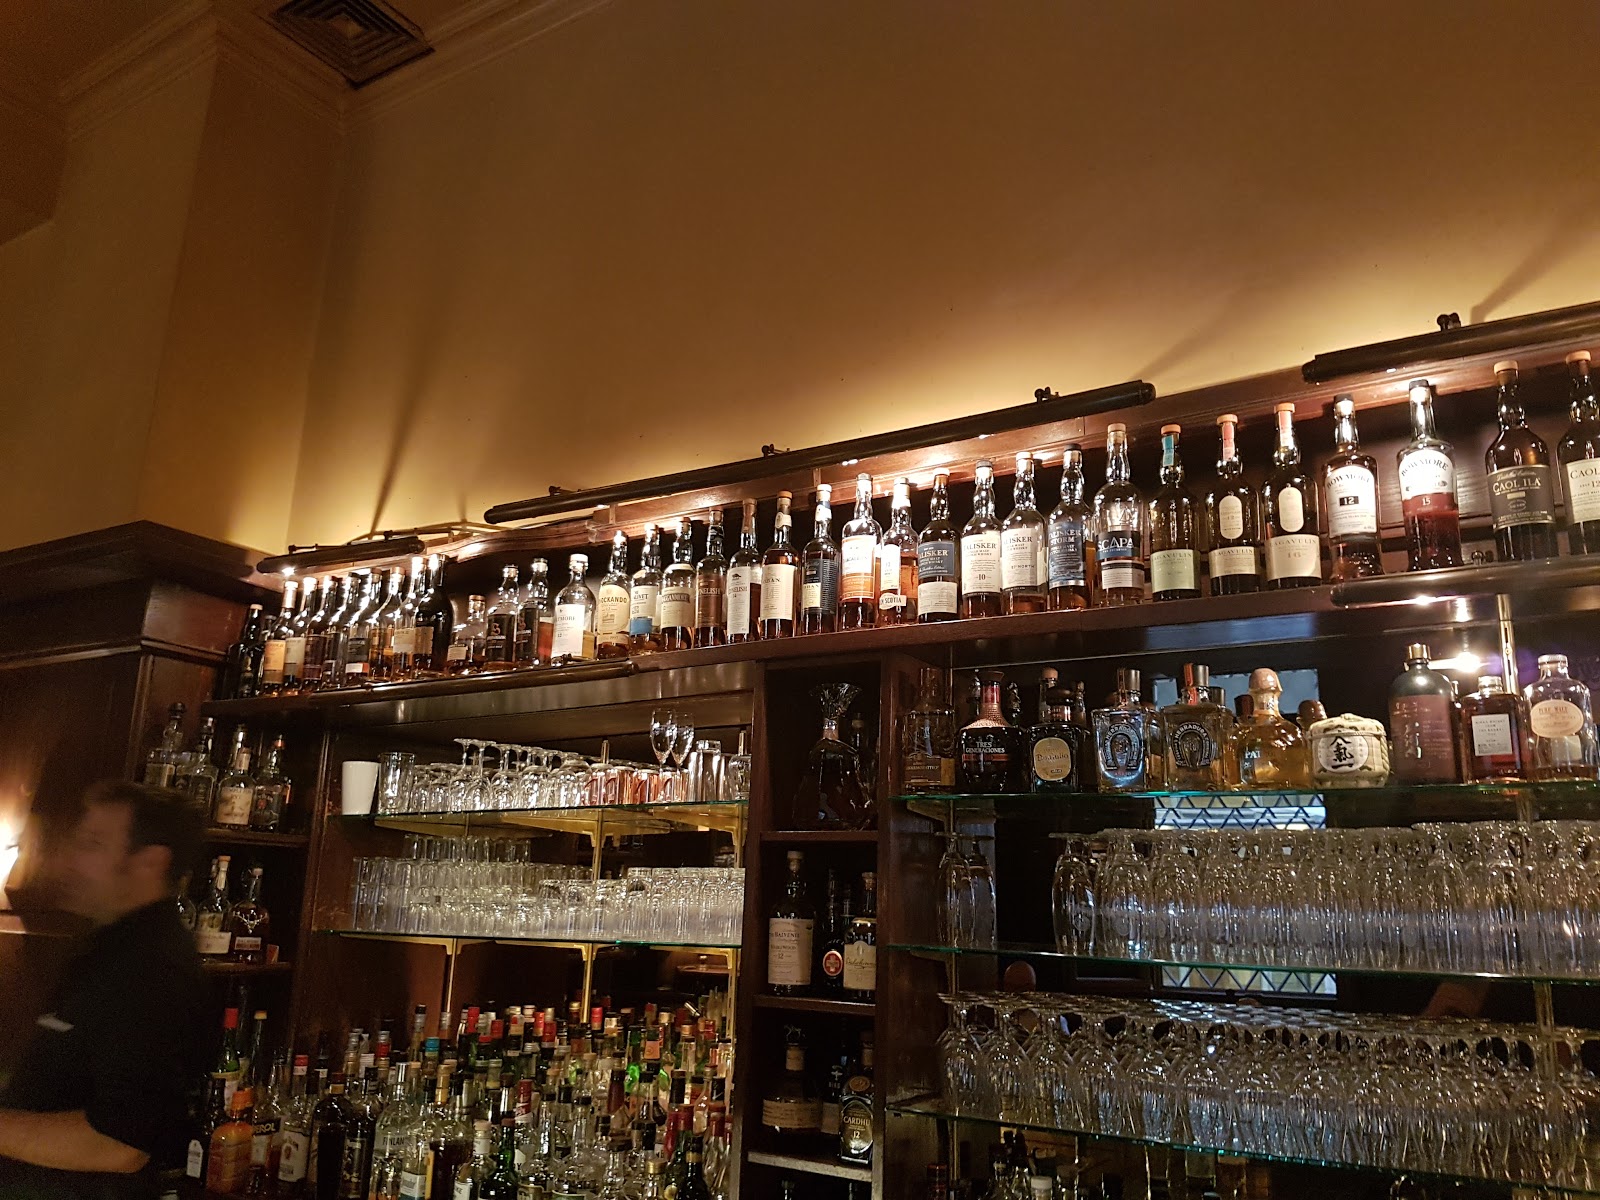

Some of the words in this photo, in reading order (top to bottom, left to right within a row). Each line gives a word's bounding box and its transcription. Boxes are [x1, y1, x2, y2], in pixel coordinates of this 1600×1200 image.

[1493, 479, 1519, 493] CAOL
[1523, 477, 1541, 488] ILA
[1343, 496, 1355, 505] 12
[1422, 496, 1431, 506] 15
[1097, 536, 1135, 551] SCAPA
[919, 549, 948, 559] LISKER
[978, 573, 986, 581] 10
[601, 596, 628, 604] OCKANDO
[843, 1116, 871, 1126] CARDHU
[853, 1130, 861, 1139] 12
